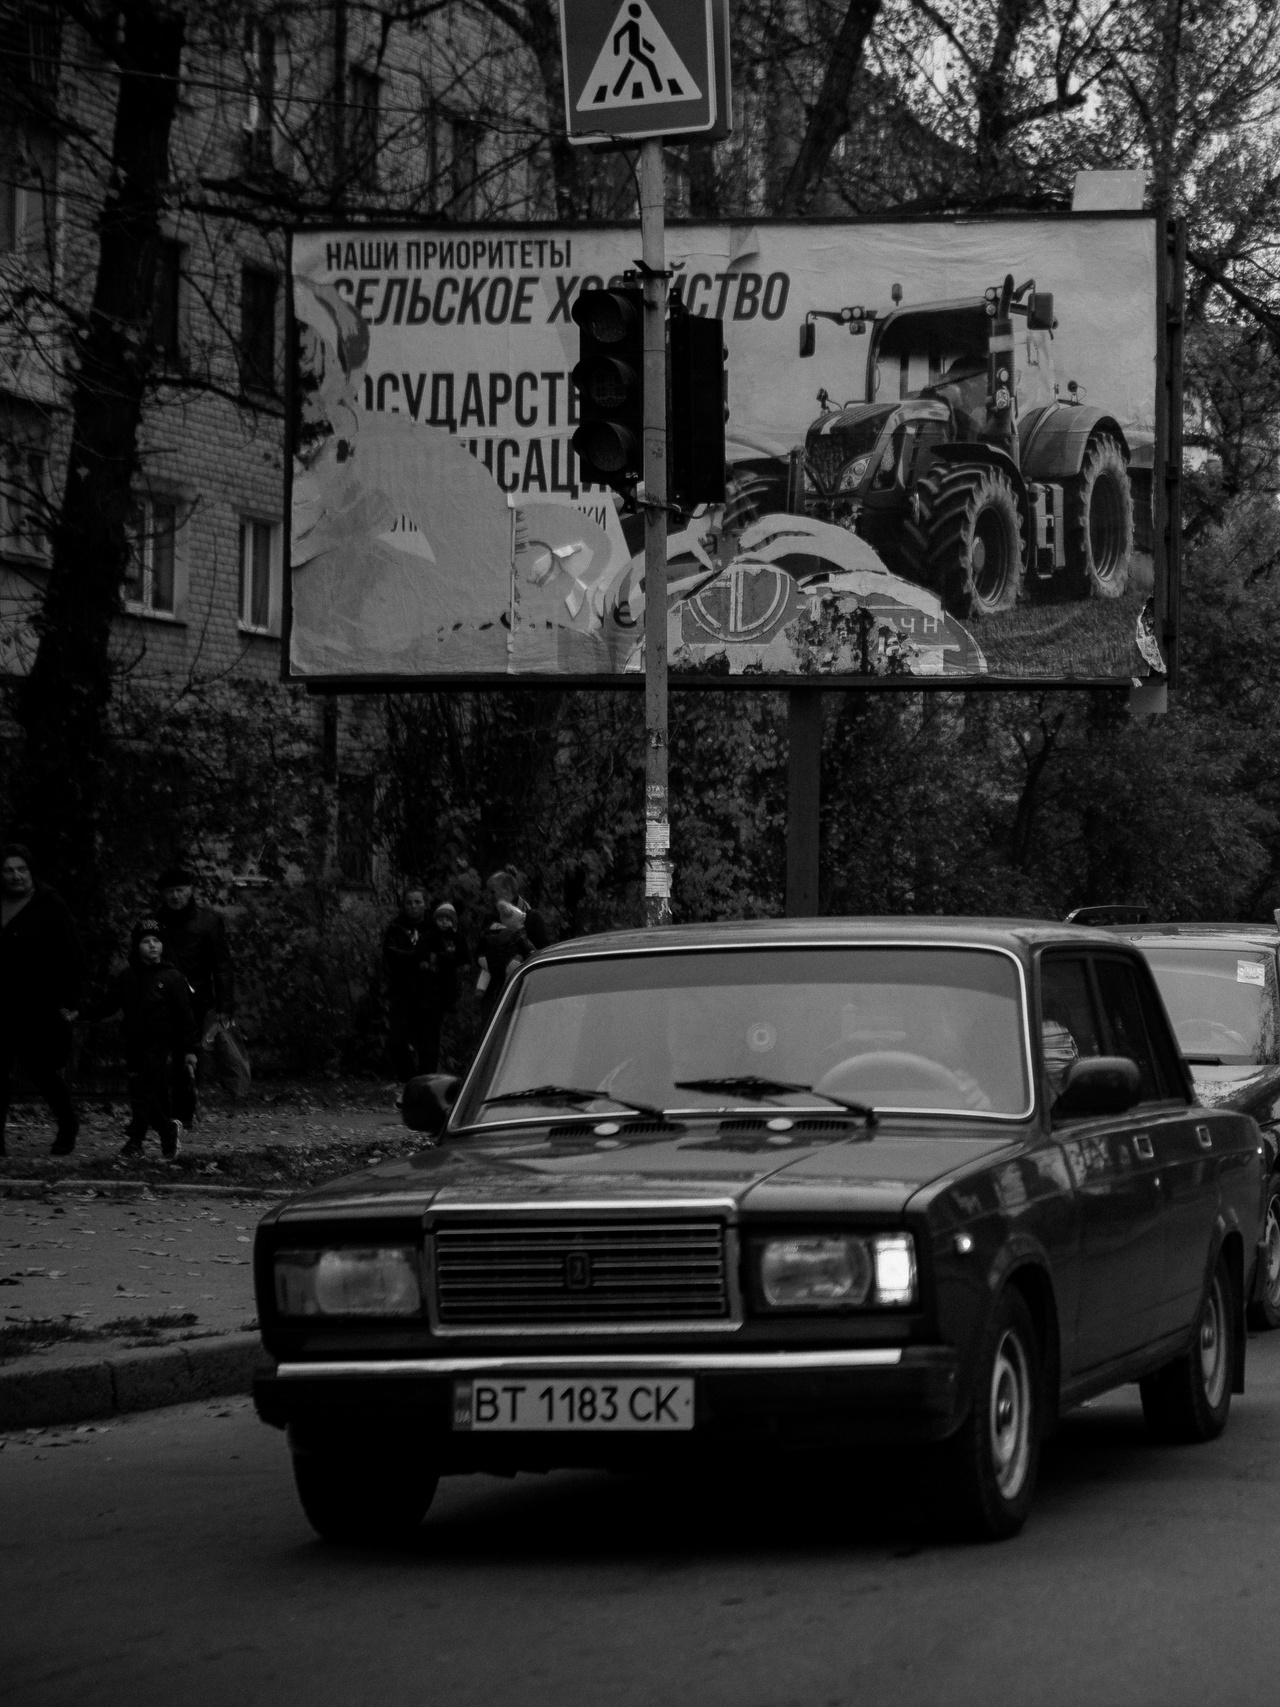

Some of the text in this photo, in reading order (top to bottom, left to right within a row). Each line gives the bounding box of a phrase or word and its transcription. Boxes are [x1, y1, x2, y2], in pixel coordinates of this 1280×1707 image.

[326, 239, 571, 271] НАШИ ПРИОРИТЕТЫ
[546, 262, 791, 325] ХСТВО
[476, 1386, 679, 1422] BT 1183 CK
